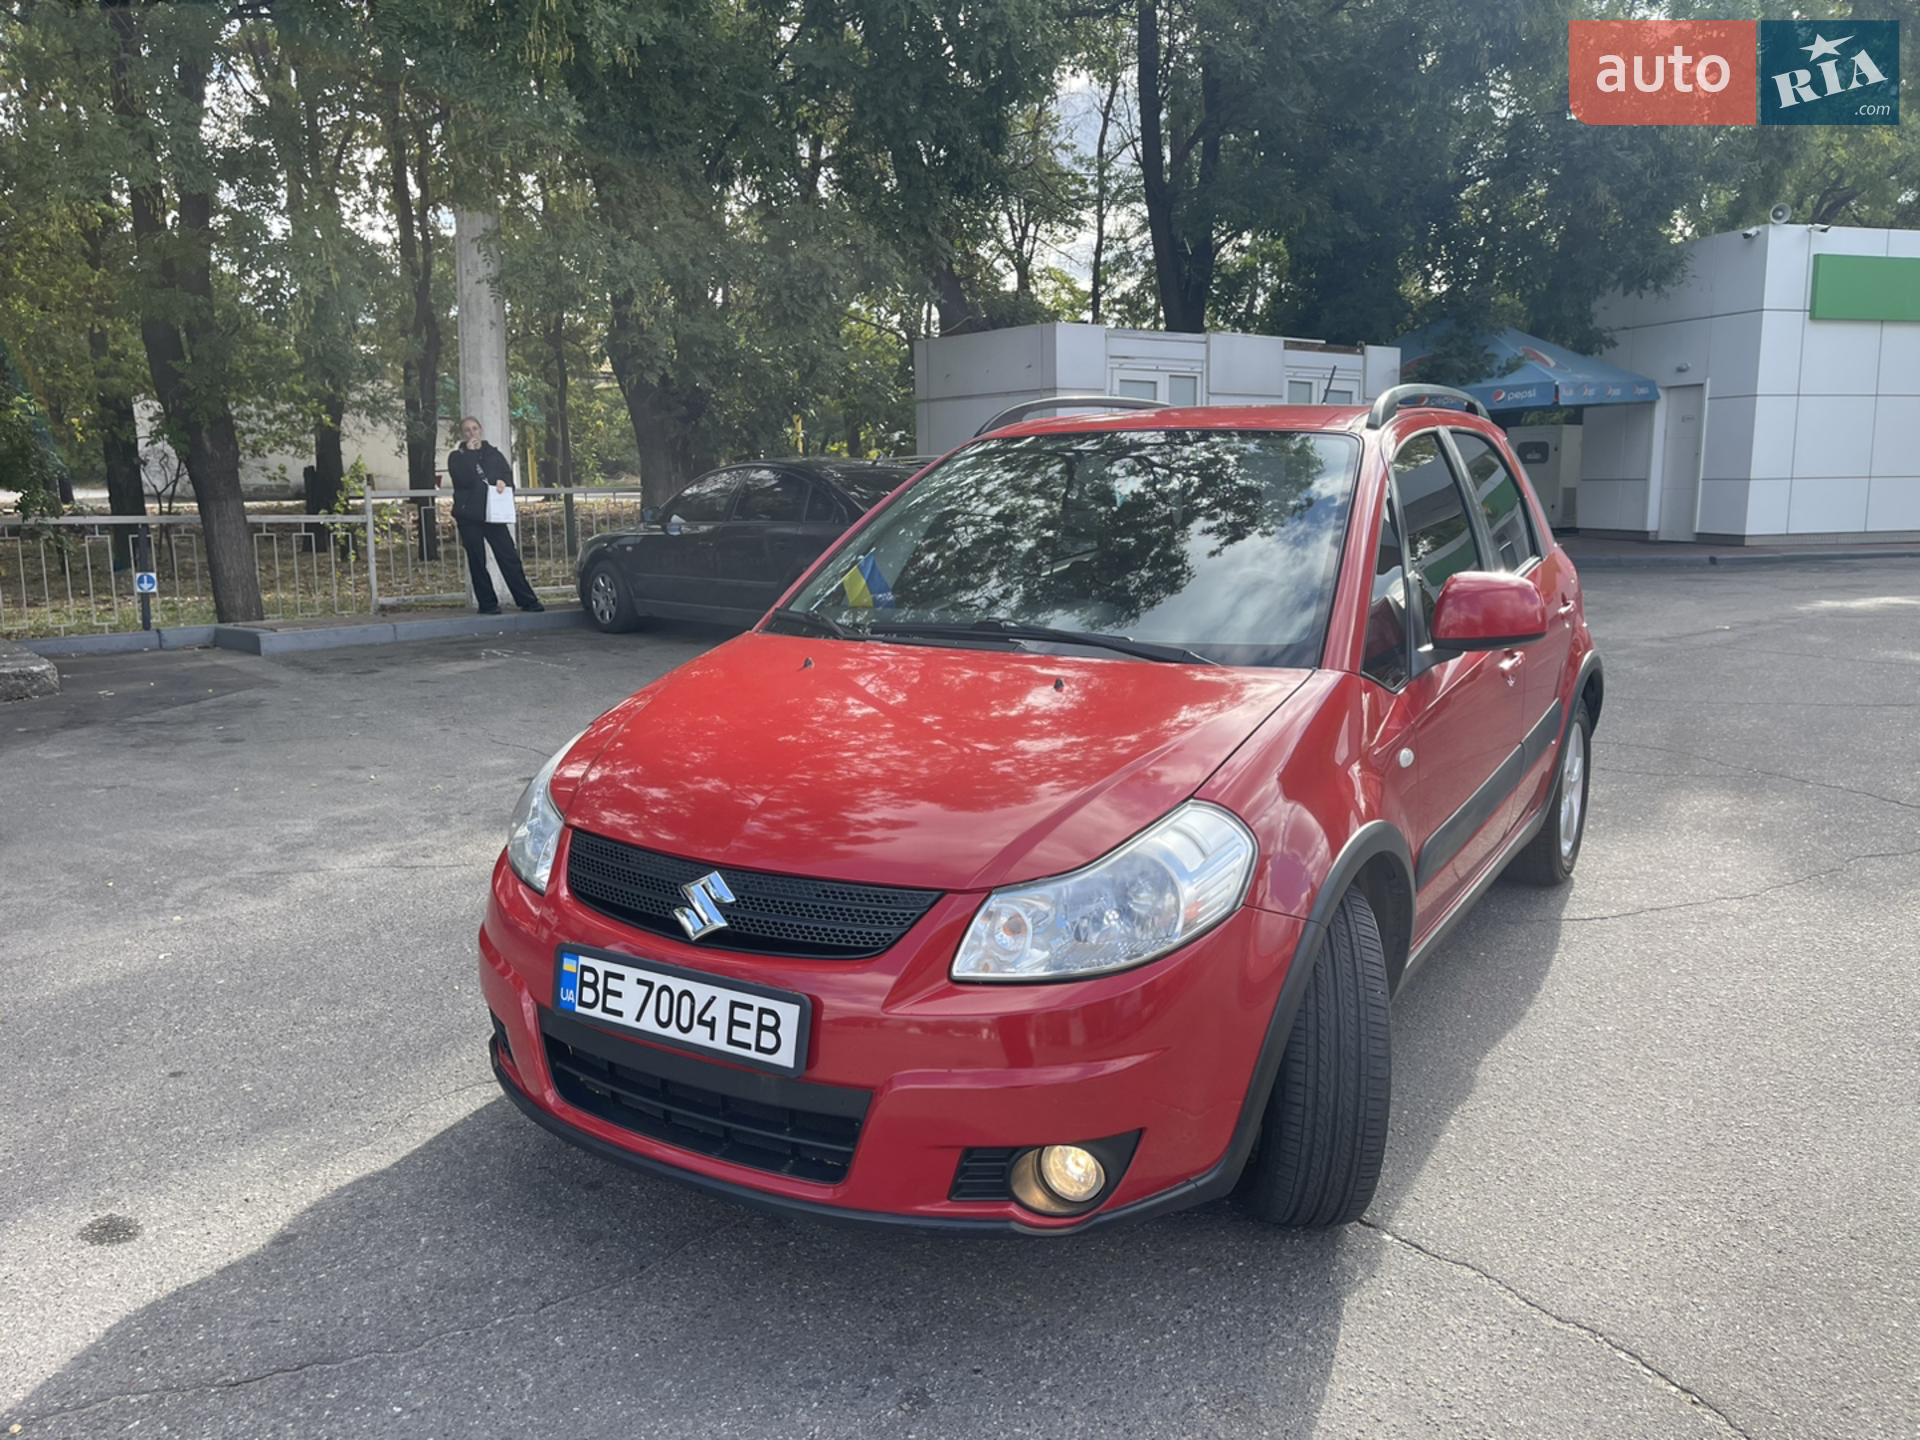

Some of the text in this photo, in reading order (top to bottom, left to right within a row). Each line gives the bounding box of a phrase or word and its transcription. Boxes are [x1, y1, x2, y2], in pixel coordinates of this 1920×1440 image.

[1507, 387, 1537, 401] pepsi
[560, 987, 576, 1003] UA
[577, 964, 782, 1056] BE 7004 EB
